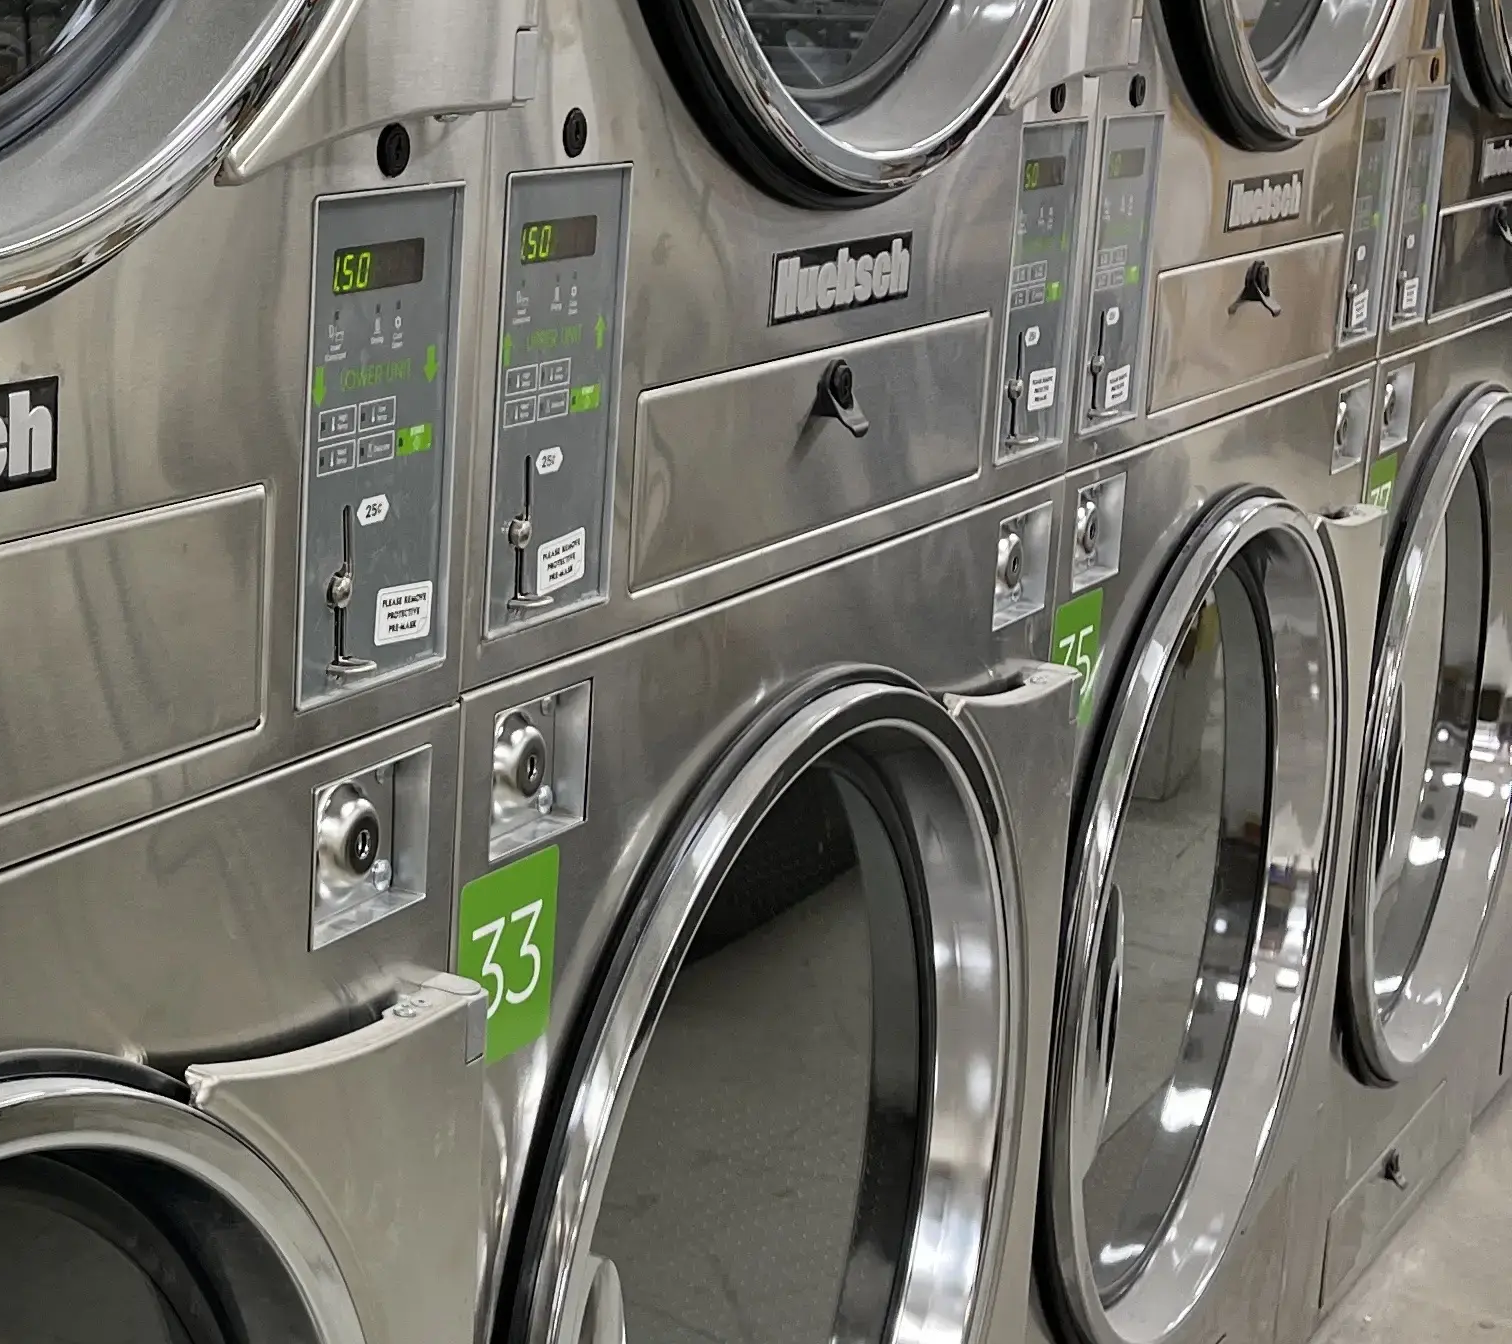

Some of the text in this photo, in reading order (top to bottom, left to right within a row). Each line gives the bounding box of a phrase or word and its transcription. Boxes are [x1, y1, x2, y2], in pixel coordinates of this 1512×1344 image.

[1228, 172, 1301, 228] Huebsch
[774, 238, 910, 319] Huebsch
[340, 357, 412, 392] LOWER UNIT
[382, 592, 427, 609] PLEASE REMOVE
[387, 606, 420, 620] PROTECTIVE
[388, 619, 417, 634] PRE-MASK
[472, 898, 543, 1019] 33
